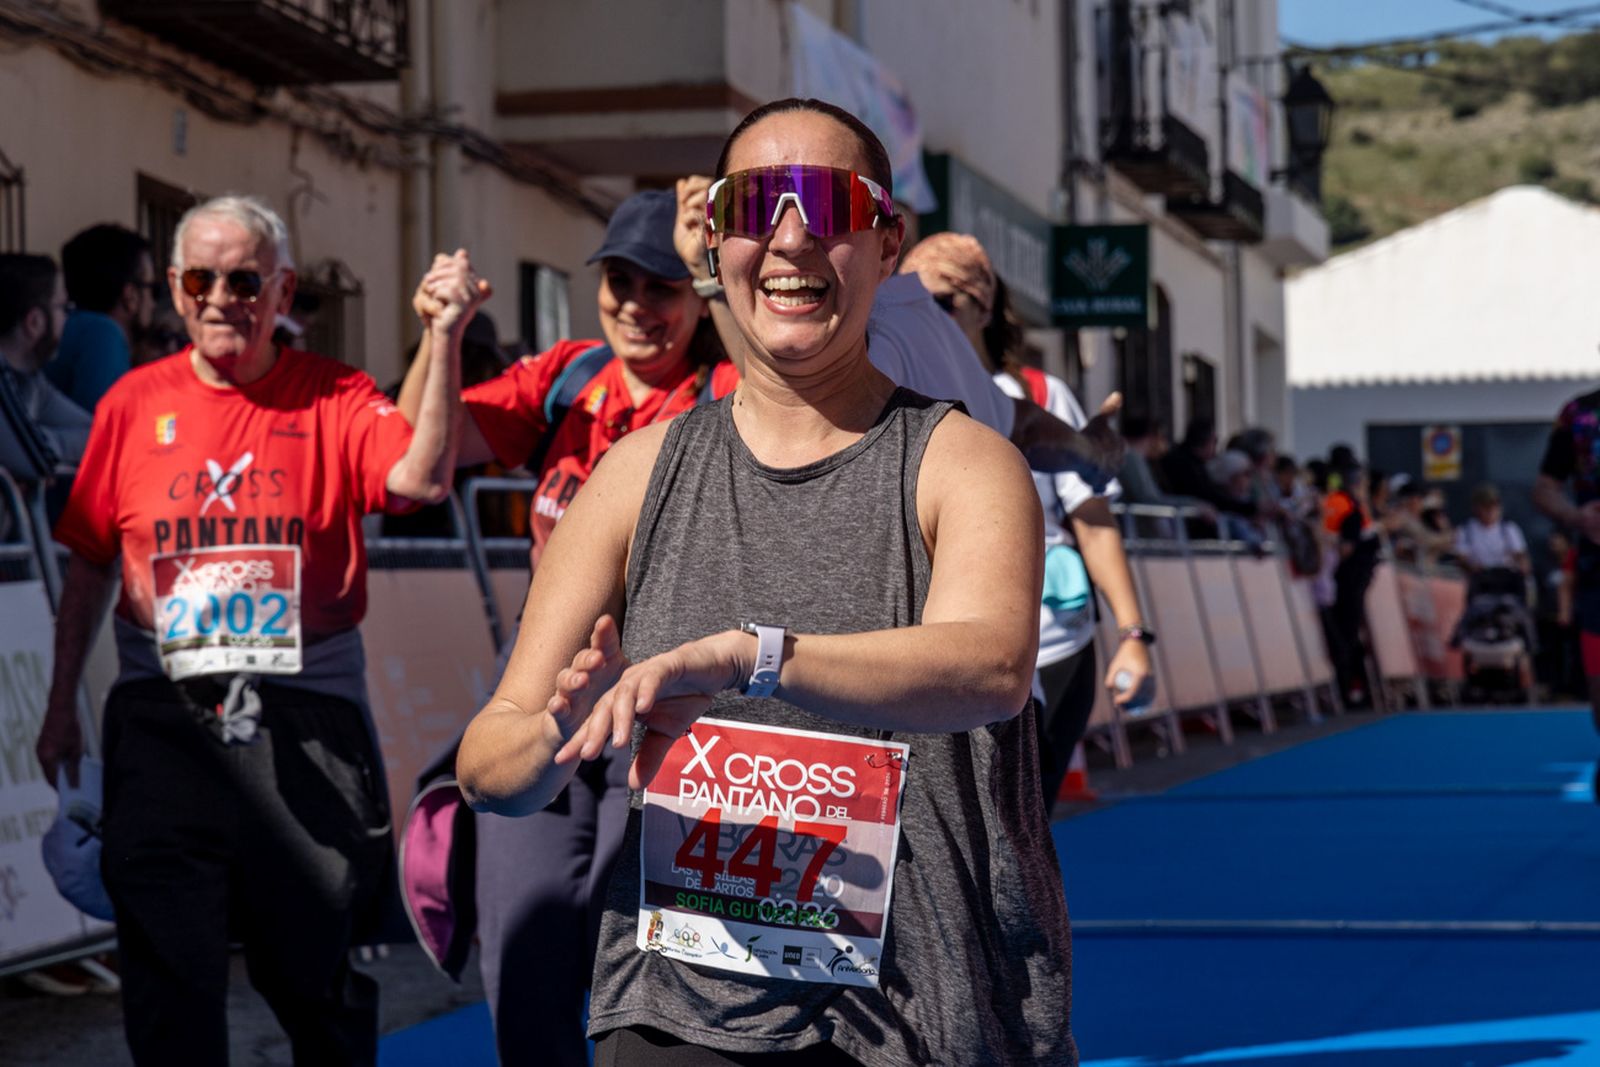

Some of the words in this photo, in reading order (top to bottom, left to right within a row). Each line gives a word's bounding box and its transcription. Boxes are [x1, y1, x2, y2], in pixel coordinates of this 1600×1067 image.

[169, 468, 286, 500] CROSS
[154, 516, 305, 553] PANTANO
[165, 592, 289, 641] 2002
[681, 731, 721, 779] X
[724, 752, 856, 798] CROSS
[678, 778, 822, 823] PANTANO
[826, 804, 852, 820] DEL
[675, 807, 848, 903] 447
[675, 892, 725, 914] SOFIA
